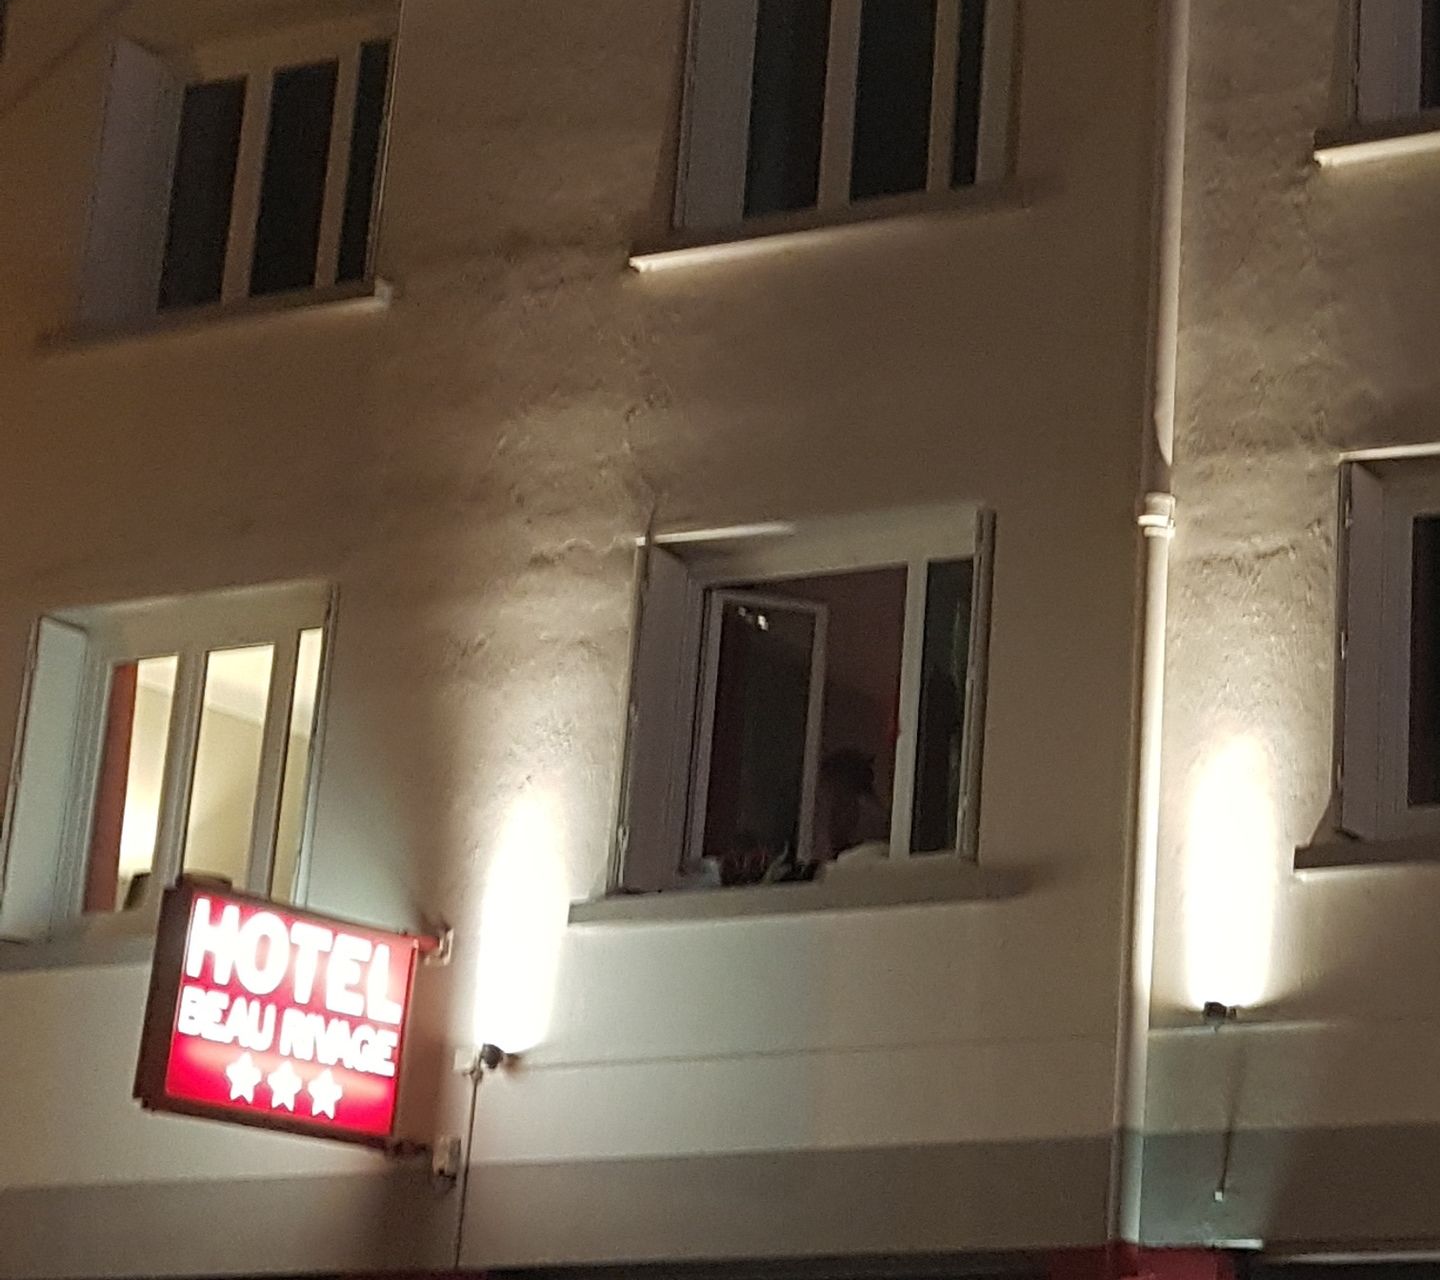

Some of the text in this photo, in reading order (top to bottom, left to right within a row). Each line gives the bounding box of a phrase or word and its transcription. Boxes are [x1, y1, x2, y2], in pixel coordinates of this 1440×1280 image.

[185, 898, 403, 1025] HOTEL
[177, 985, 399, 1077] BEAU RIVAGE
